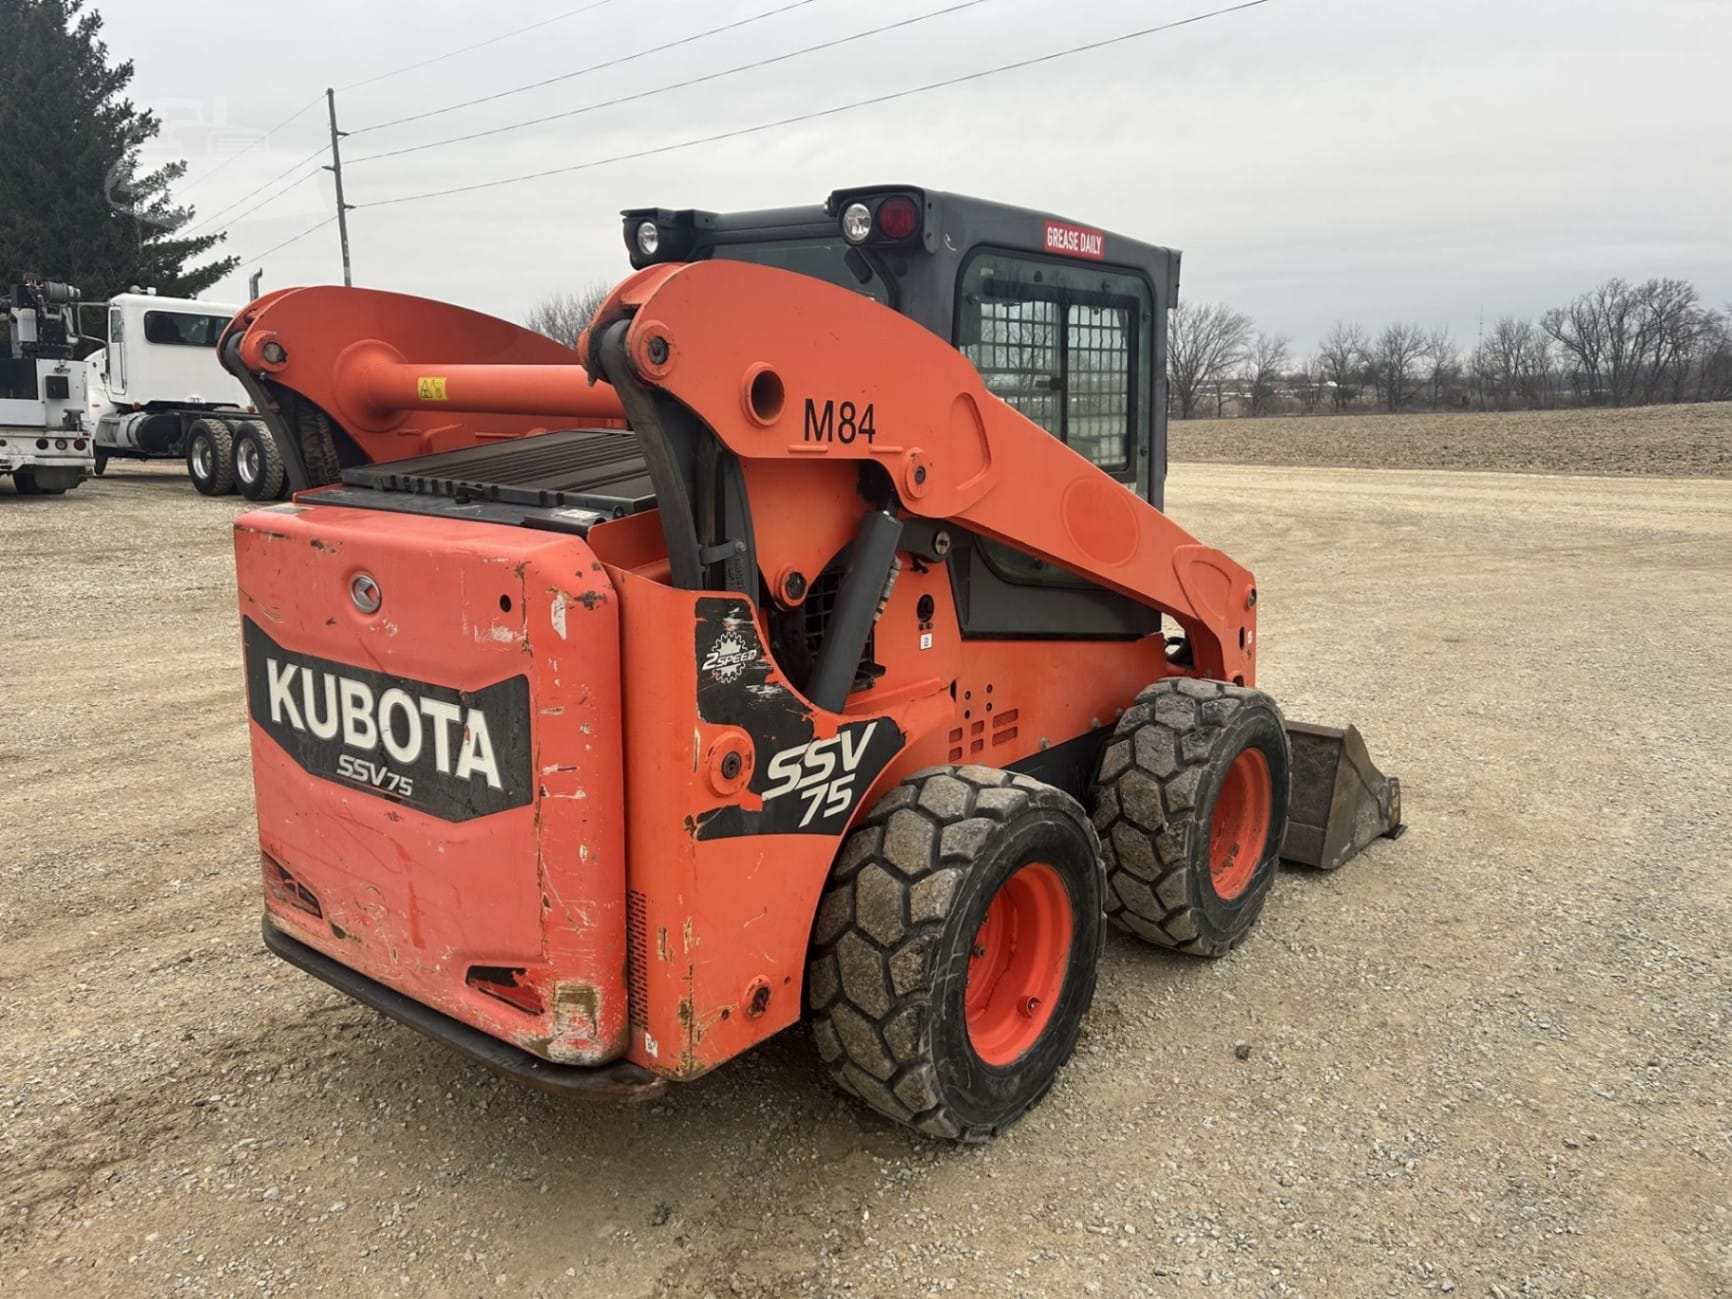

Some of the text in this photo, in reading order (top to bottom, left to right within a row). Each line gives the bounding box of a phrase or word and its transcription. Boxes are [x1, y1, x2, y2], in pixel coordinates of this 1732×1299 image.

[1047, 227, 1102, 255] GREASE DAILY
[804, 398, 876, 444] M84
[266, 658, 503, 791] KUBOTA
[761, 722, 878, 801] SSV
[798, 774, 855, 828] 75
